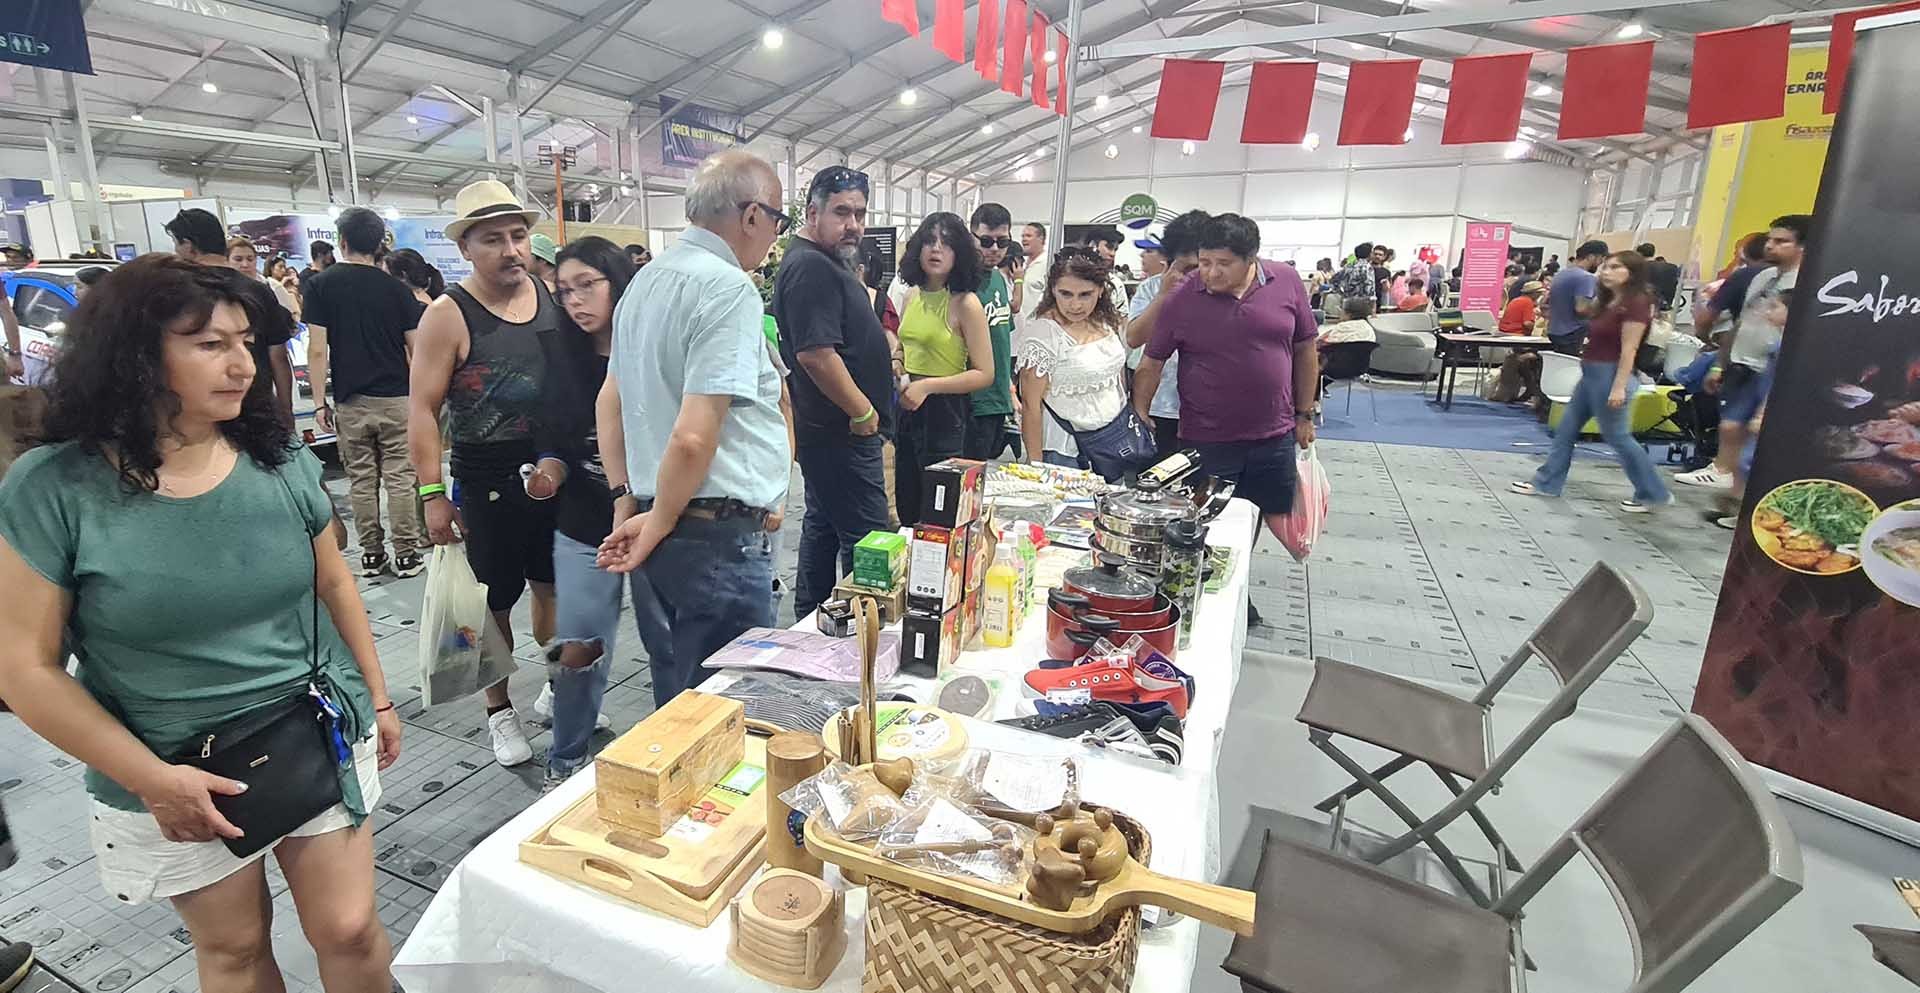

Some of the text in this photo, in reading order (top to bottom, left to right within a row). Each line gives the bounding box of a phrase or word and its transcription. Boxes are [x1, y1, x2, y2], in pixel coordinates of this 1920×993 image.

[1786, 82, 1825, 95] ERNA
[1123, 204, 1153, 216] SQM
[307, 227, 339, 242] Infrap
[424, 228, 447, 241] Infrap
